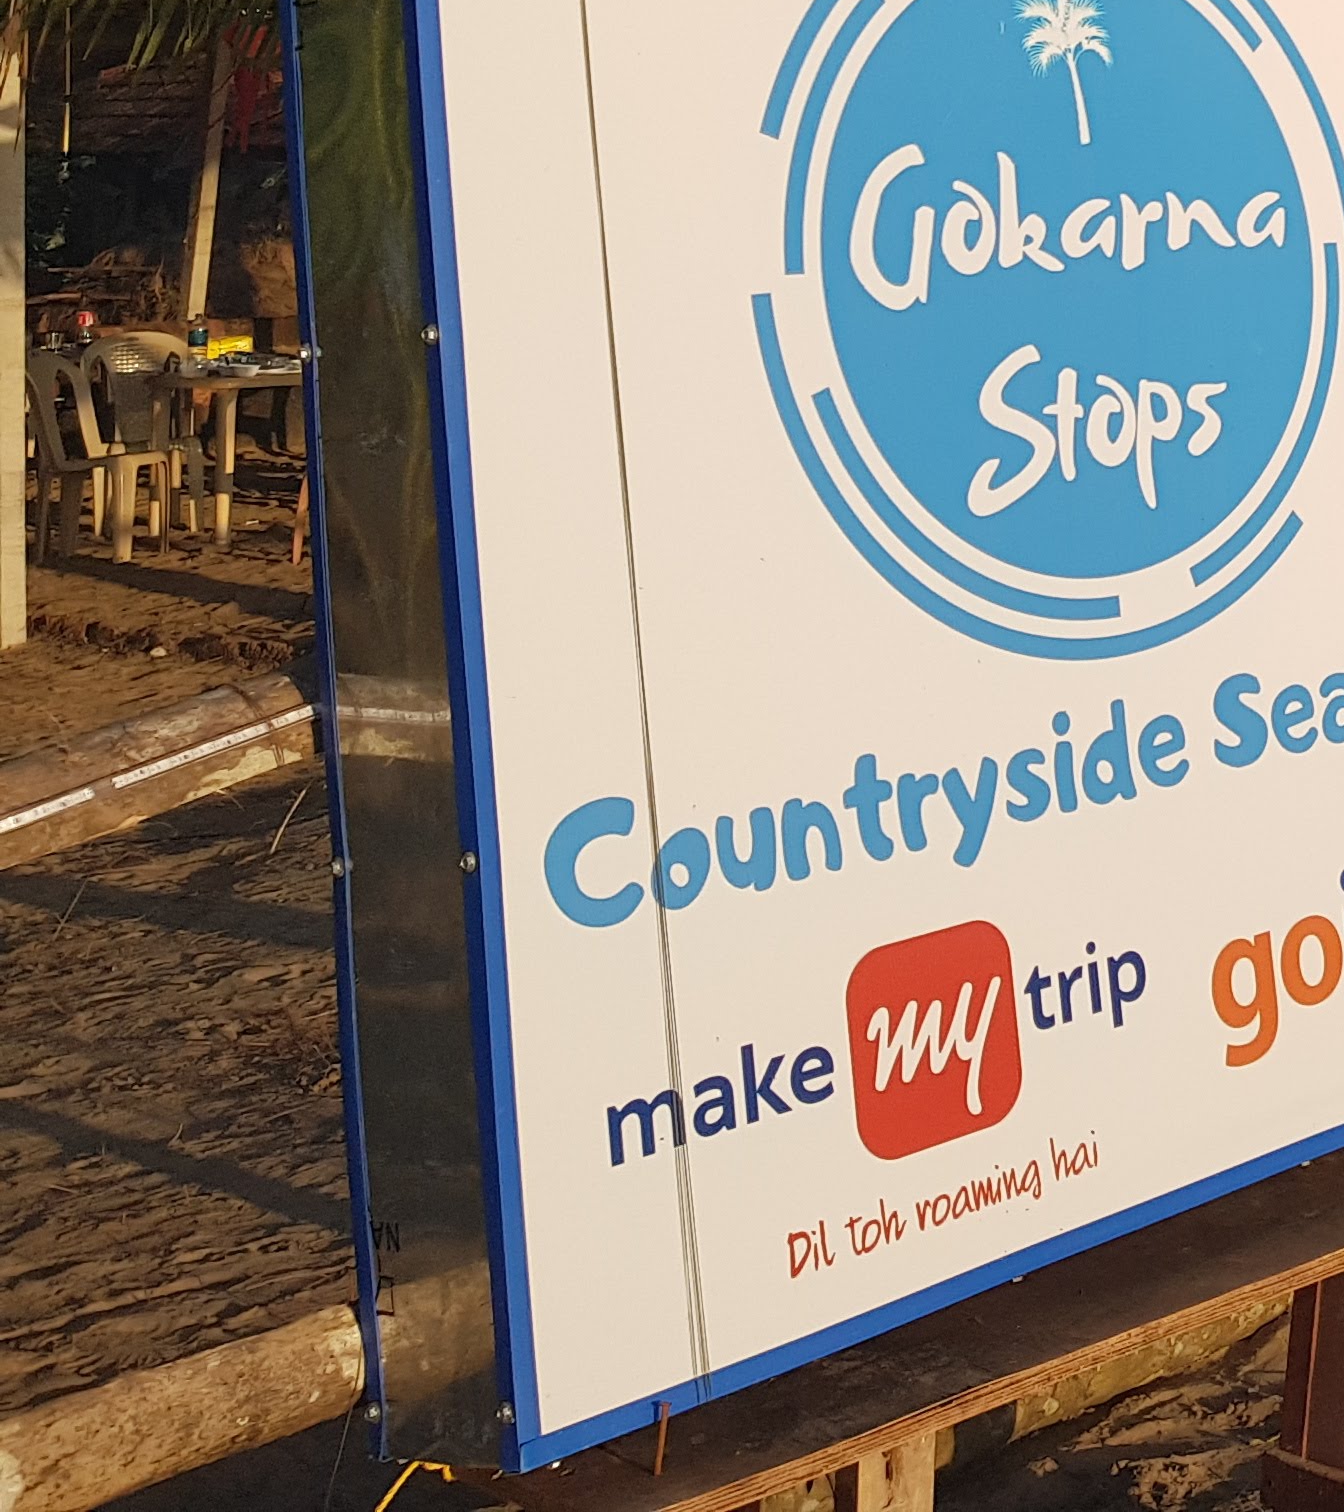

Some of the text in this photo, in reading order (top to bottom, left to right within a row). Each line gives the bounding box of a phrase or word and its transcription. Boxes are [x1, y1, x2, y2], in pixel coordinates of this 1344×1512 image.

[848, 142, 1287, 312] Gokarna
[966, 343, 1228, 518] Stops
[544, 698, 1190, 928] Countryside
[607, 941, 1147, 1167] make my trip
[785, 1130, 1101, 1281] Dil toh roaming hai
